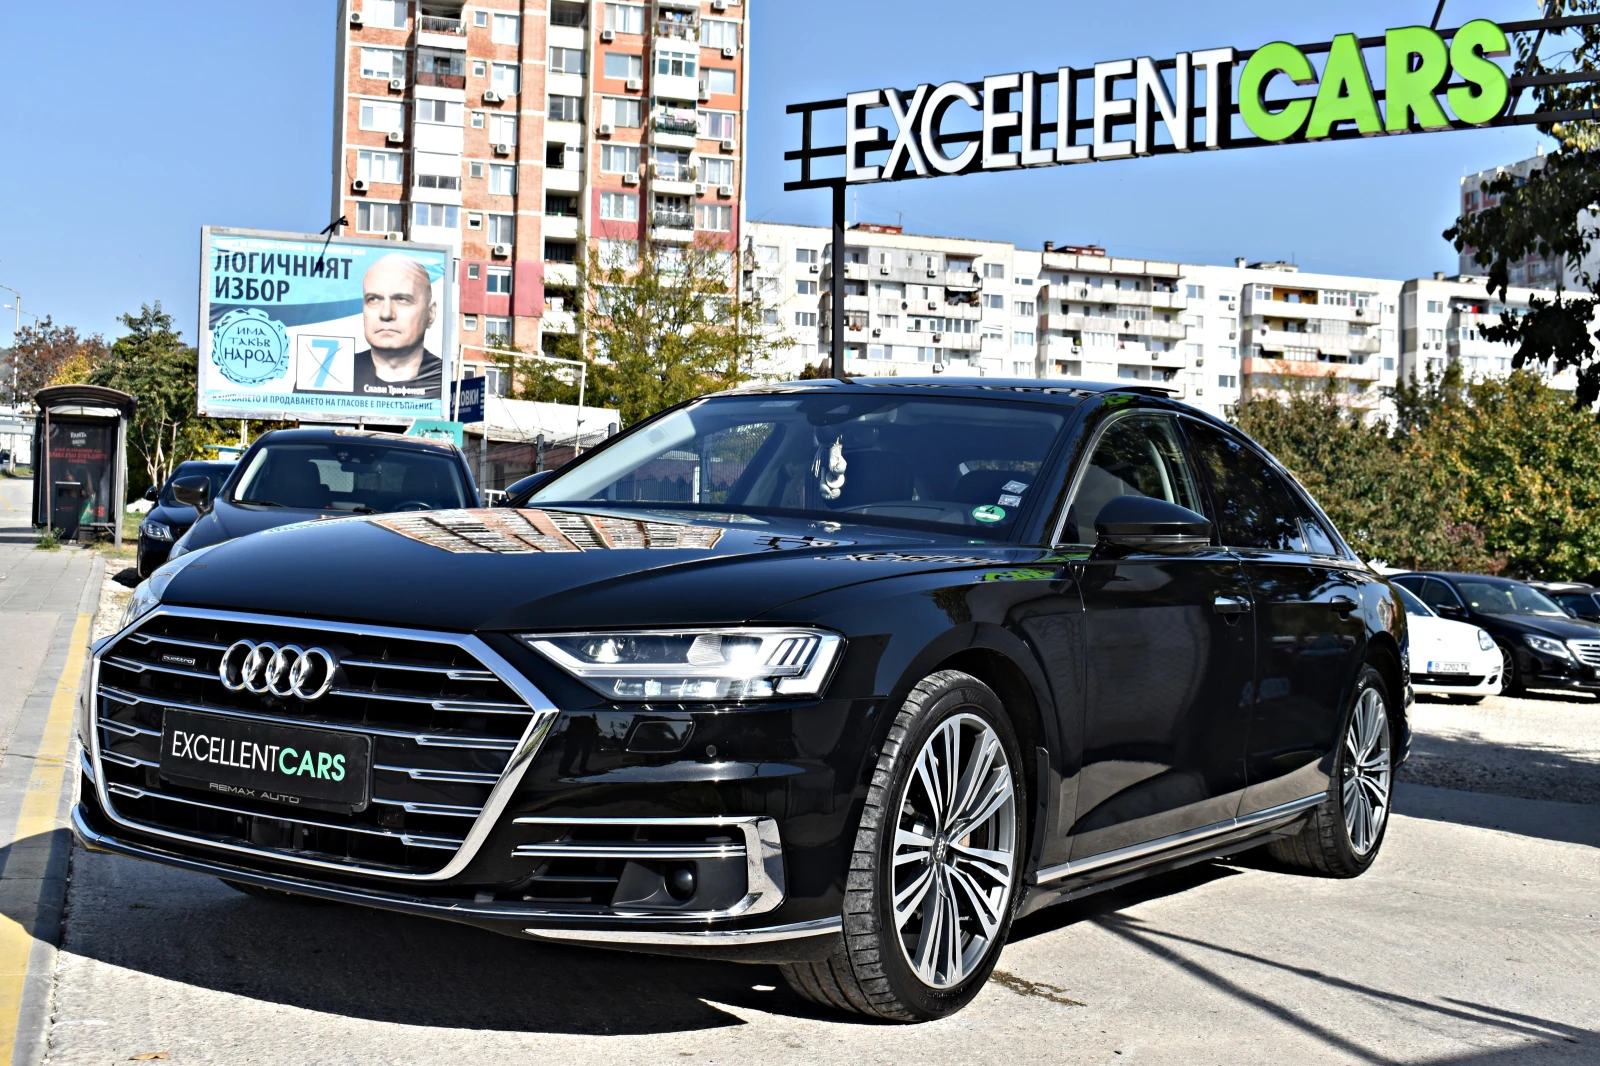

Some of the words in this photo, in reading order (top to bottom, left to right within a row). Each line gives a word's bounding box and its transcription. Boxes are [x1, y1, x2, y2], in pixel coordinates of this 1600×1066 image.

[214, 250, 353, 280] ЛОГИЧНИЯТ
[215, 276, 290, 302] ИЗБОР
[237, 326, 266, 336] ИМА
[228, 336, 271, 347] ТАКЪВ
[224, 347, 277, 368] НАРОД
[312, 338, 339, 388] 7
[363, 383, 388, 394] Слави
[212, 392, 261, 403] ВАНЕТО
[262, 395, 268, 404] И
[269, 395, 324, 406] ПРОДАВАНЕТО
[325, 398, 336, 407] НА
[337, 398, 369, 408] ГЛАСОВЕ
[370, 400, 375, 408] Е
[376, 400, 434, 411] ПРЕСТЪПЛЕНИЕ
[985, 505, 995, 514] 4
[209, 782, 255, 797] REMAX
[260, 791, 300, 804] AUTO
